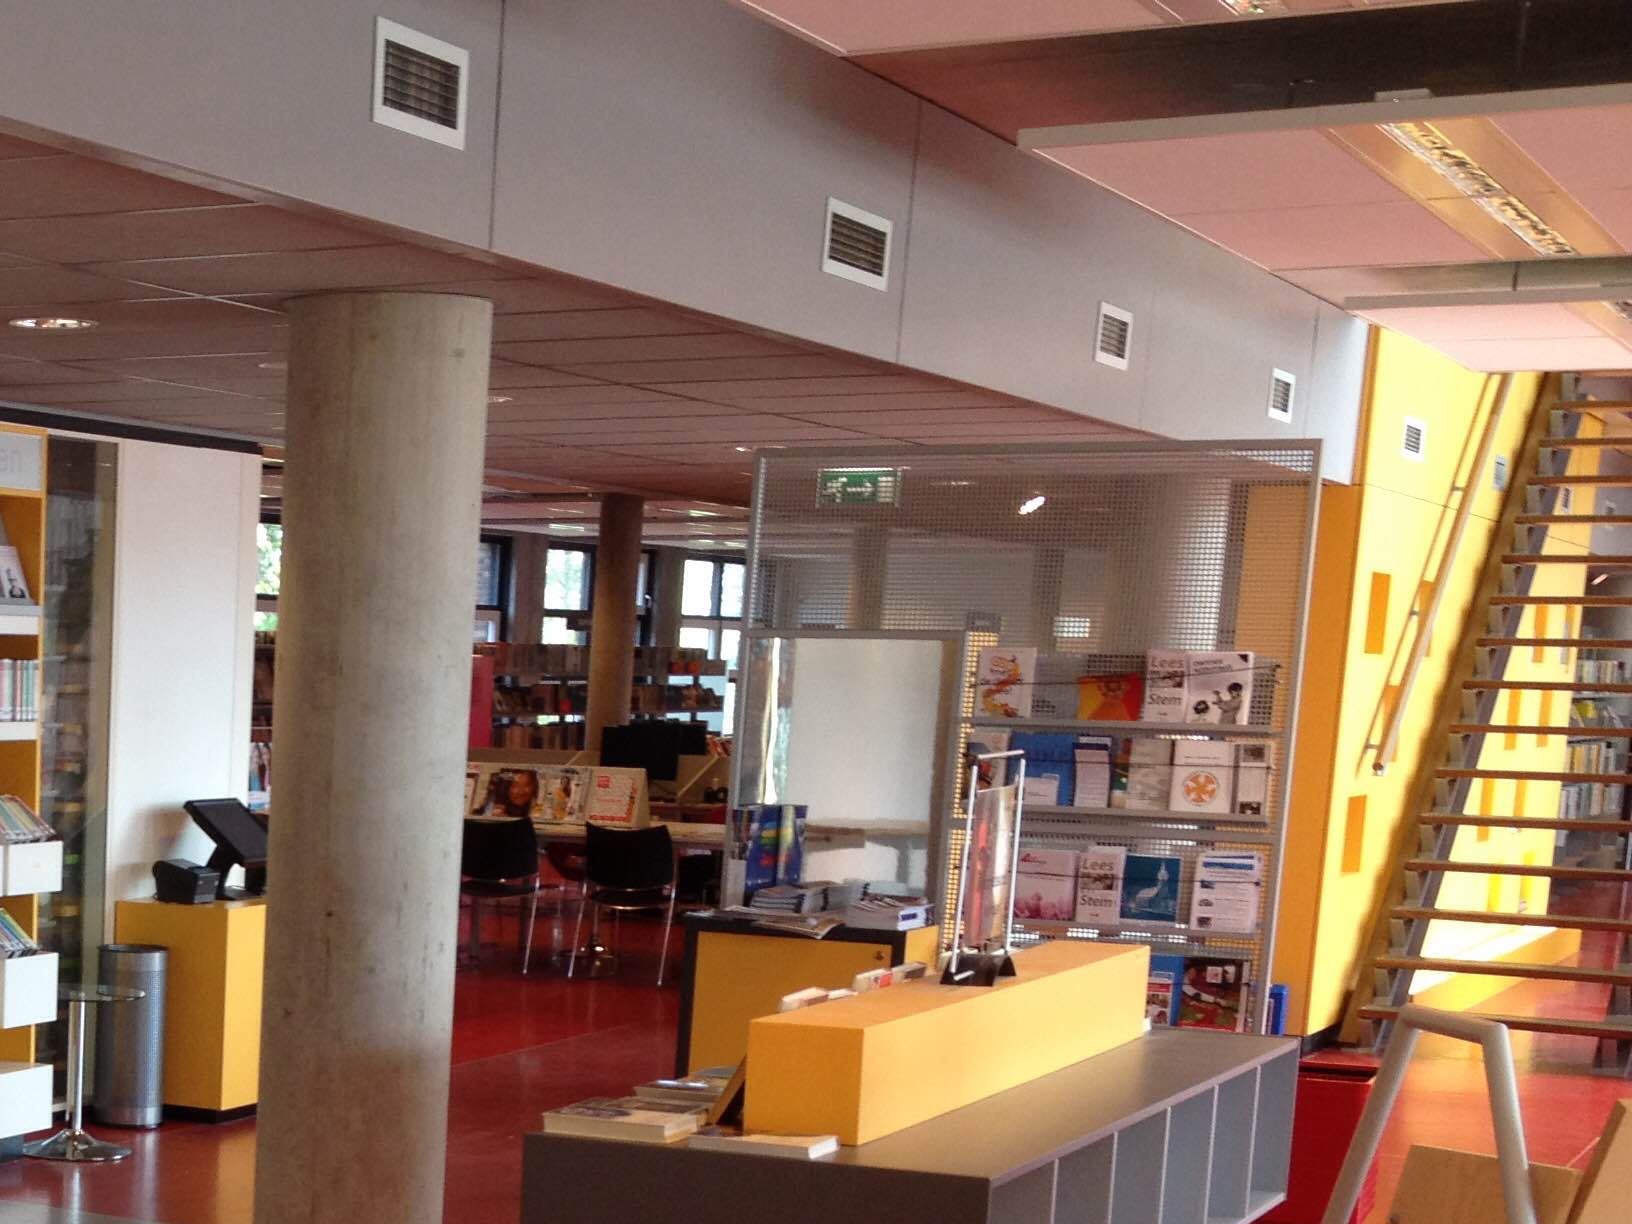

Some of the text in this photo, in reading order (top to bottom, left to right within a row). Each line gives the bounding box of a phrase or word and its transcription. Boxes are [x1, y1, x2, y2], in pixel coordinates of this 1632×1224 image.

[1149, 655, 1185, 669] Lees
[1081, 857, 1115, 872] Lees
[1079, 894, 1114, 910] Stem
